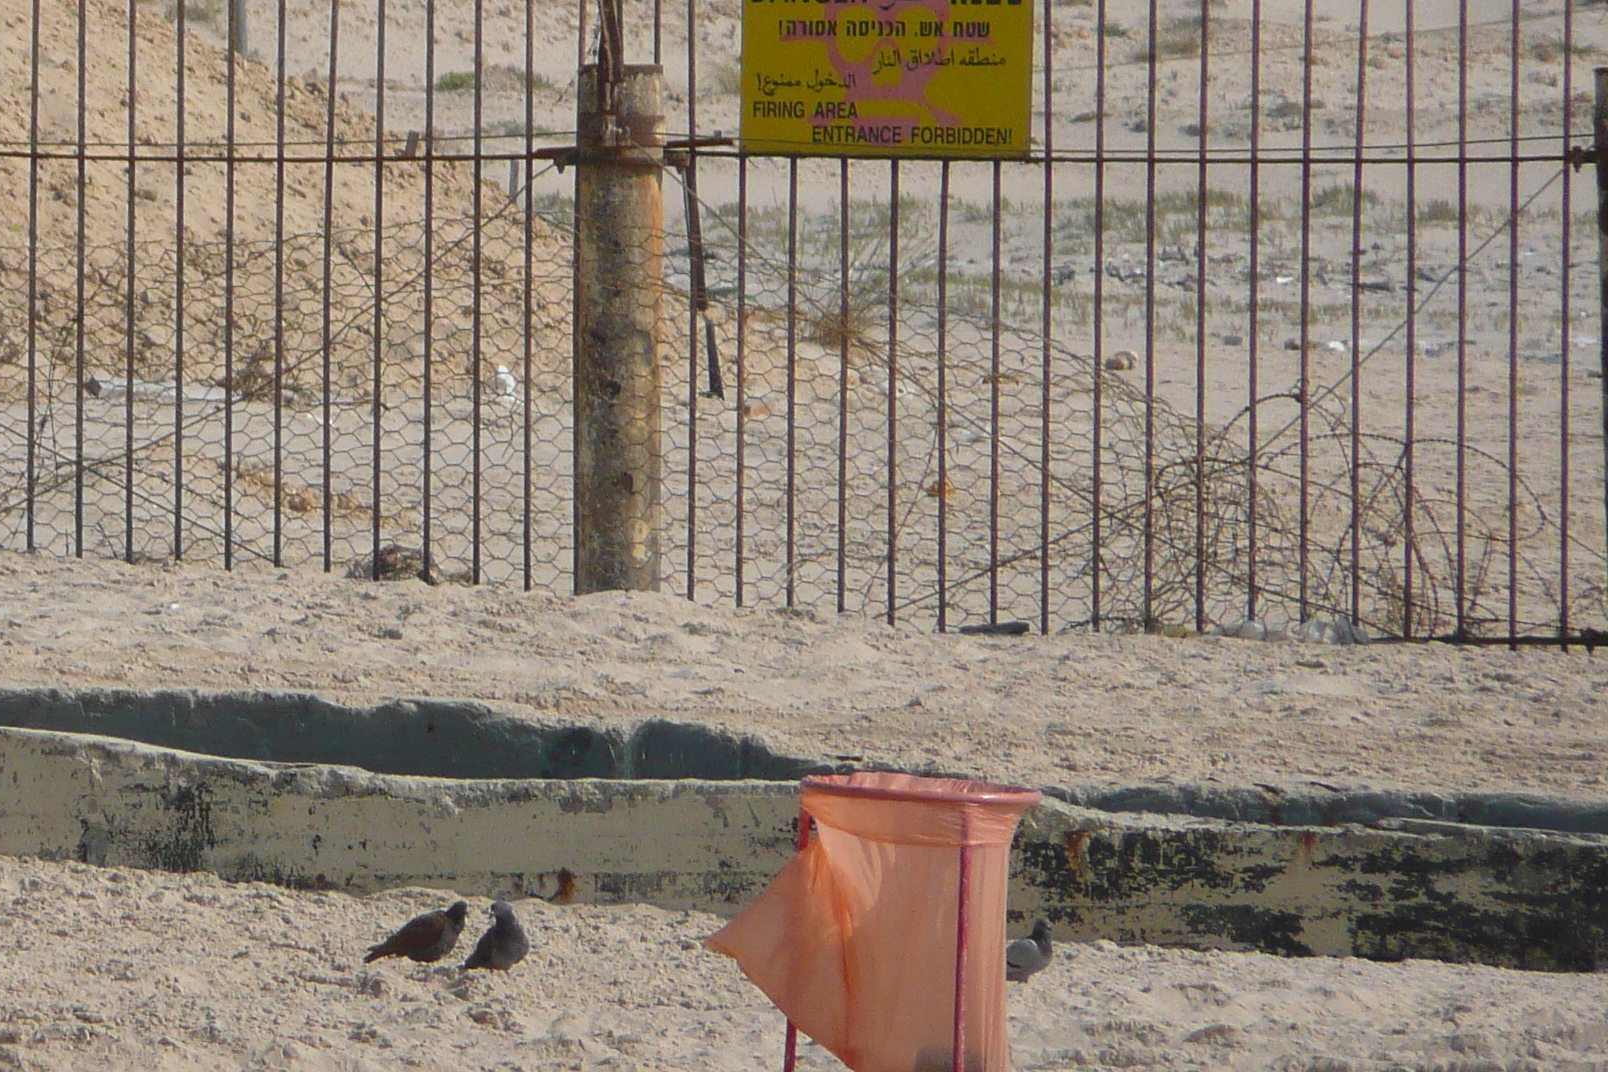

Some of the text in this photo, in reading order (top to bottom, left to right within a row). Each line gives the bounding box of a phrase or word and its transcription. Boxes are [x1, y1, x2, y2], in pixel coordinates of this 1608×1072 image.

[779, 19, 838, 36] אסורה!
[846, 20, 906, 37] הכניסה
[953, 21, 990, 37] שטח
[753, 101, 858, 119] FIRING AREA
[812, 125, 1013, 145] ENTRANCE FORBIDDEN!
